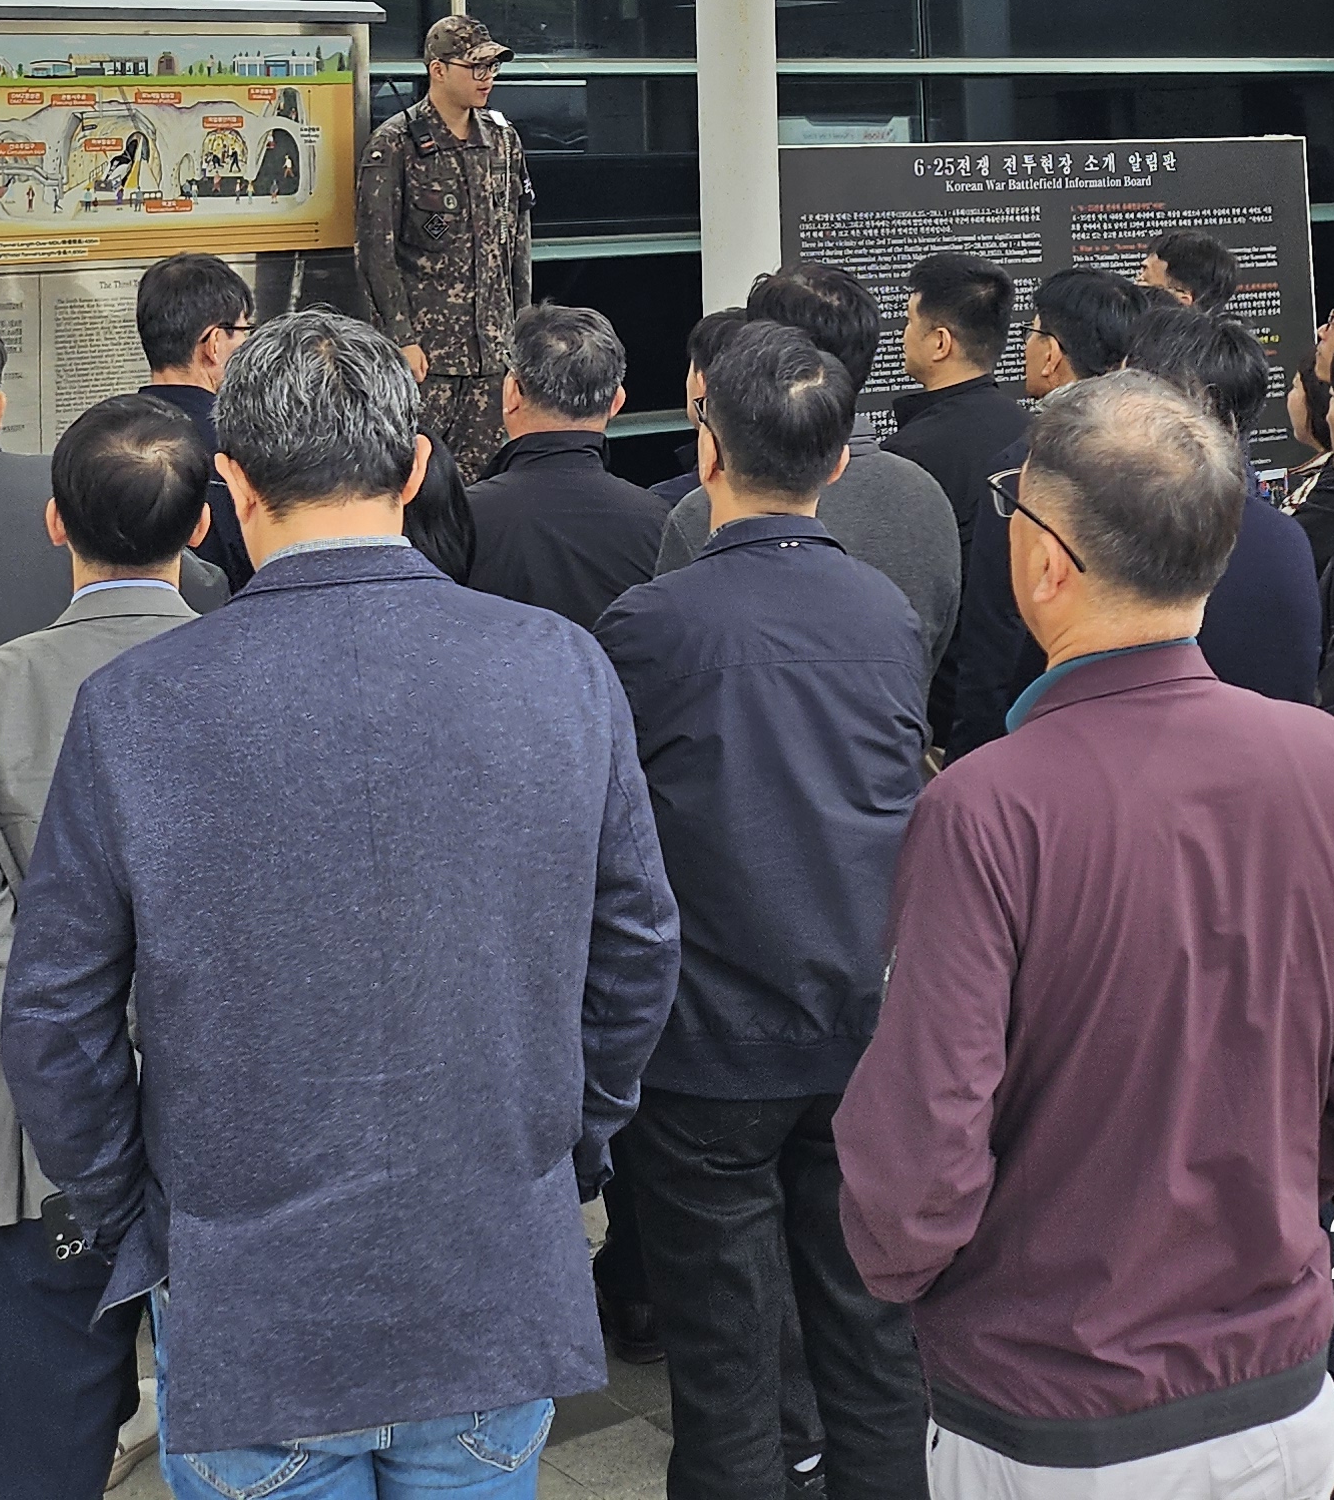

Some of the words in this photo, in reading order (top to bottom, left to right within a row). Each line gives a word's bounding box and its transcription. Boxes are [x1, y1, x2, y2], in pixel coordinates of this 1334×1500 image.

[914, 154, 990, 177] 6·25전쟁
[1002, 153, 1073, 176] 전투현장
[1084, 152, 1117, 174] 소개
[1128, 150, 1177, 173] 알림판
[945, 179, 984, 192] Korean
[986, 178, 1007, 191] War
[1008, 177, 1063, 190] Battlefield
[1064, 176, 1122, 189] Information
[1123, 175, 1152, 188] Board
